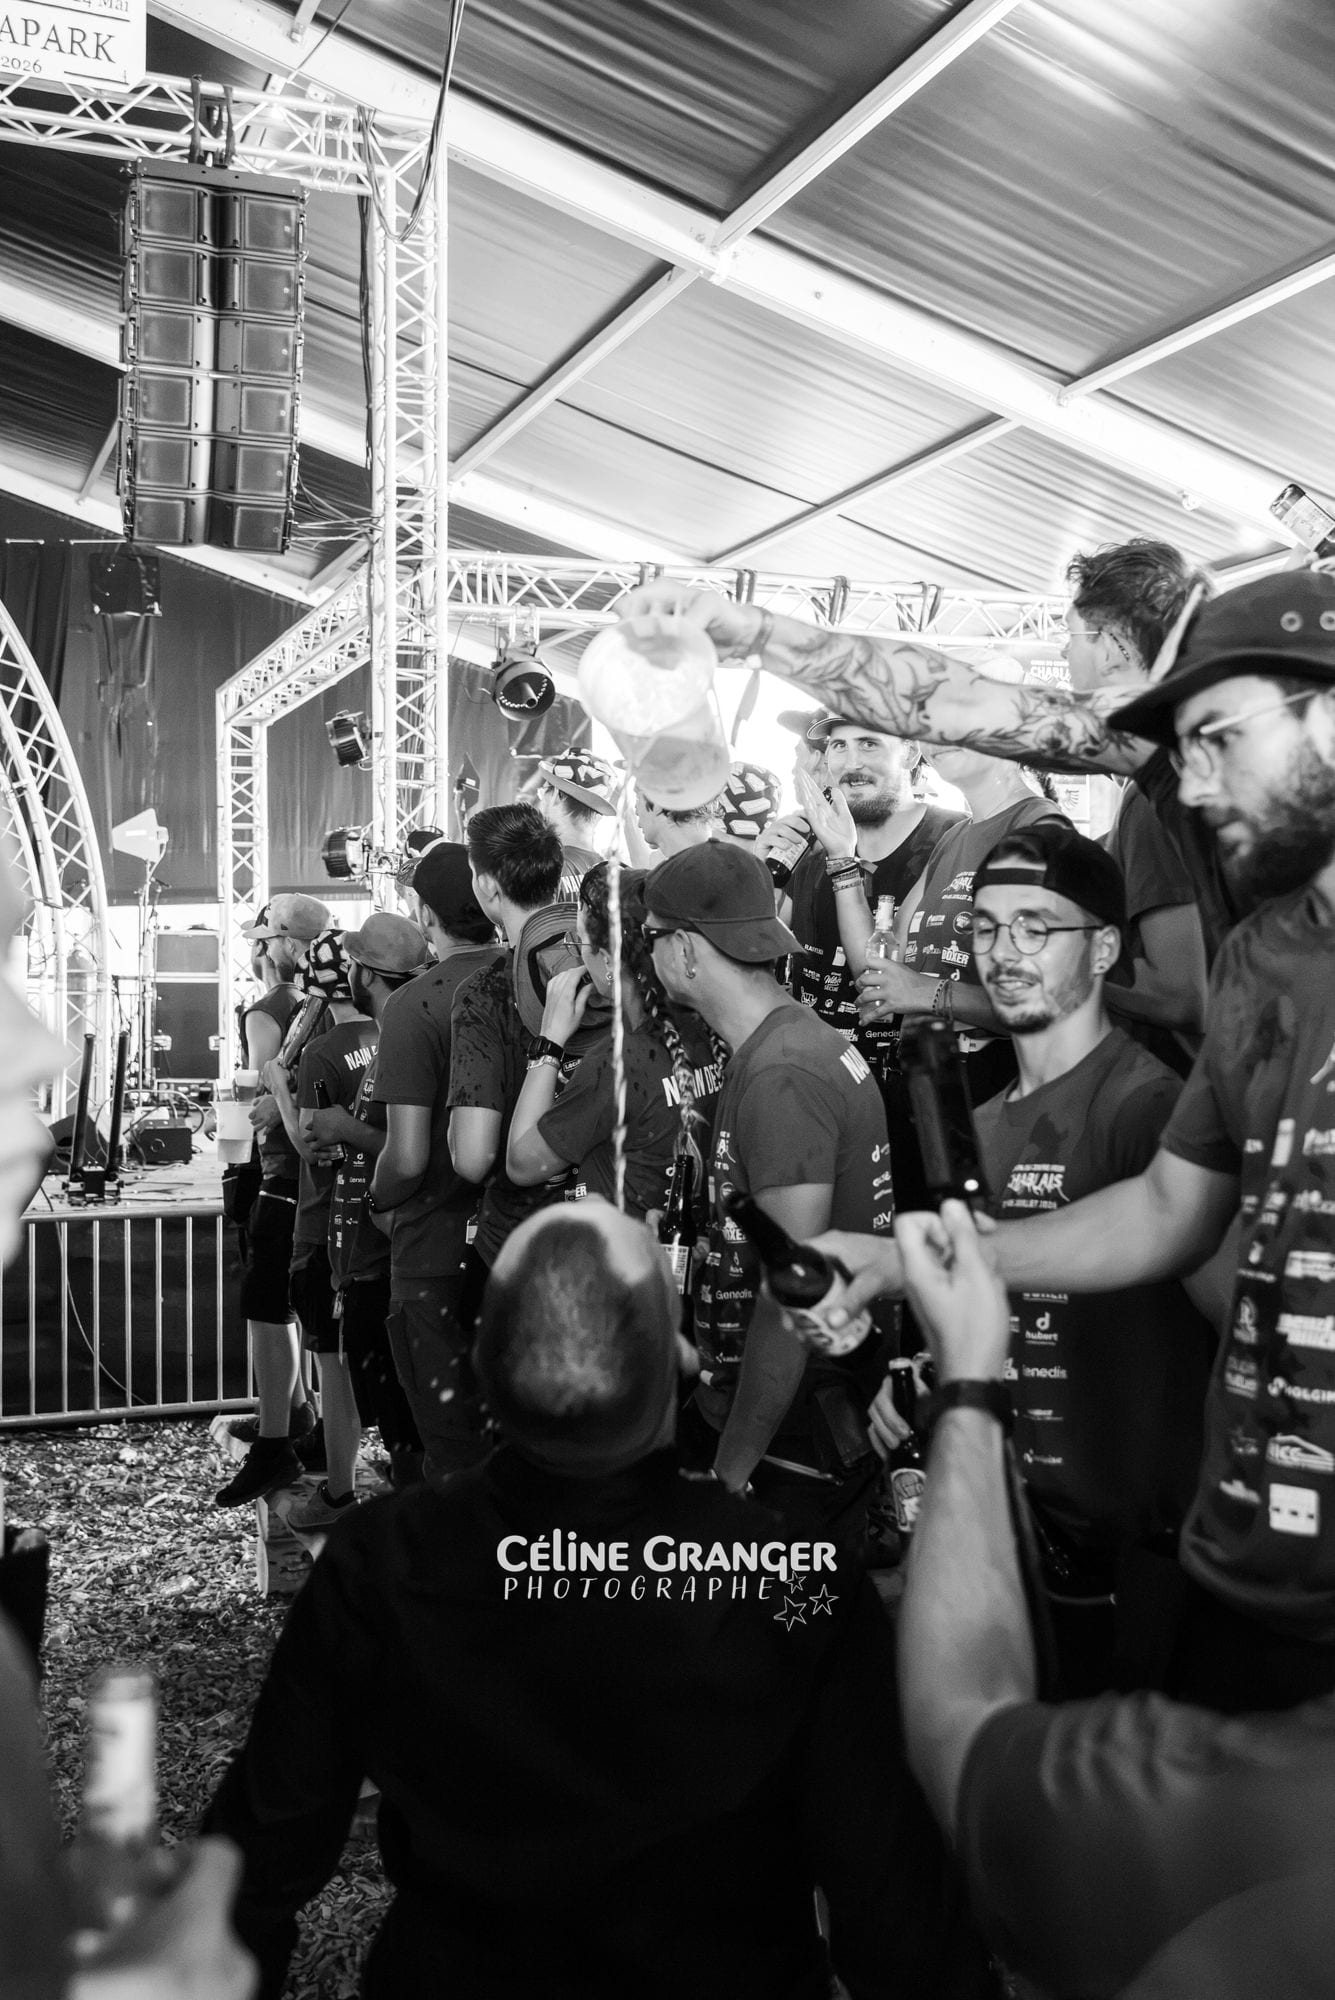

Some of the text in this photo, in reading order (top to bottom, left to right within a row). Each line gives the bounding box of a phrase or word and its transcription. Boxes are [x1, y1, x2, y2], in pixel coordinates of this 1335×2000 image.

[0, 15, 116, 63] APARK
[1, 56, 42, 74] 2026
[344, 1047, 371, 1070] NAIN
[504, 1575, 775, 1602] PHOTOGRAPHE
